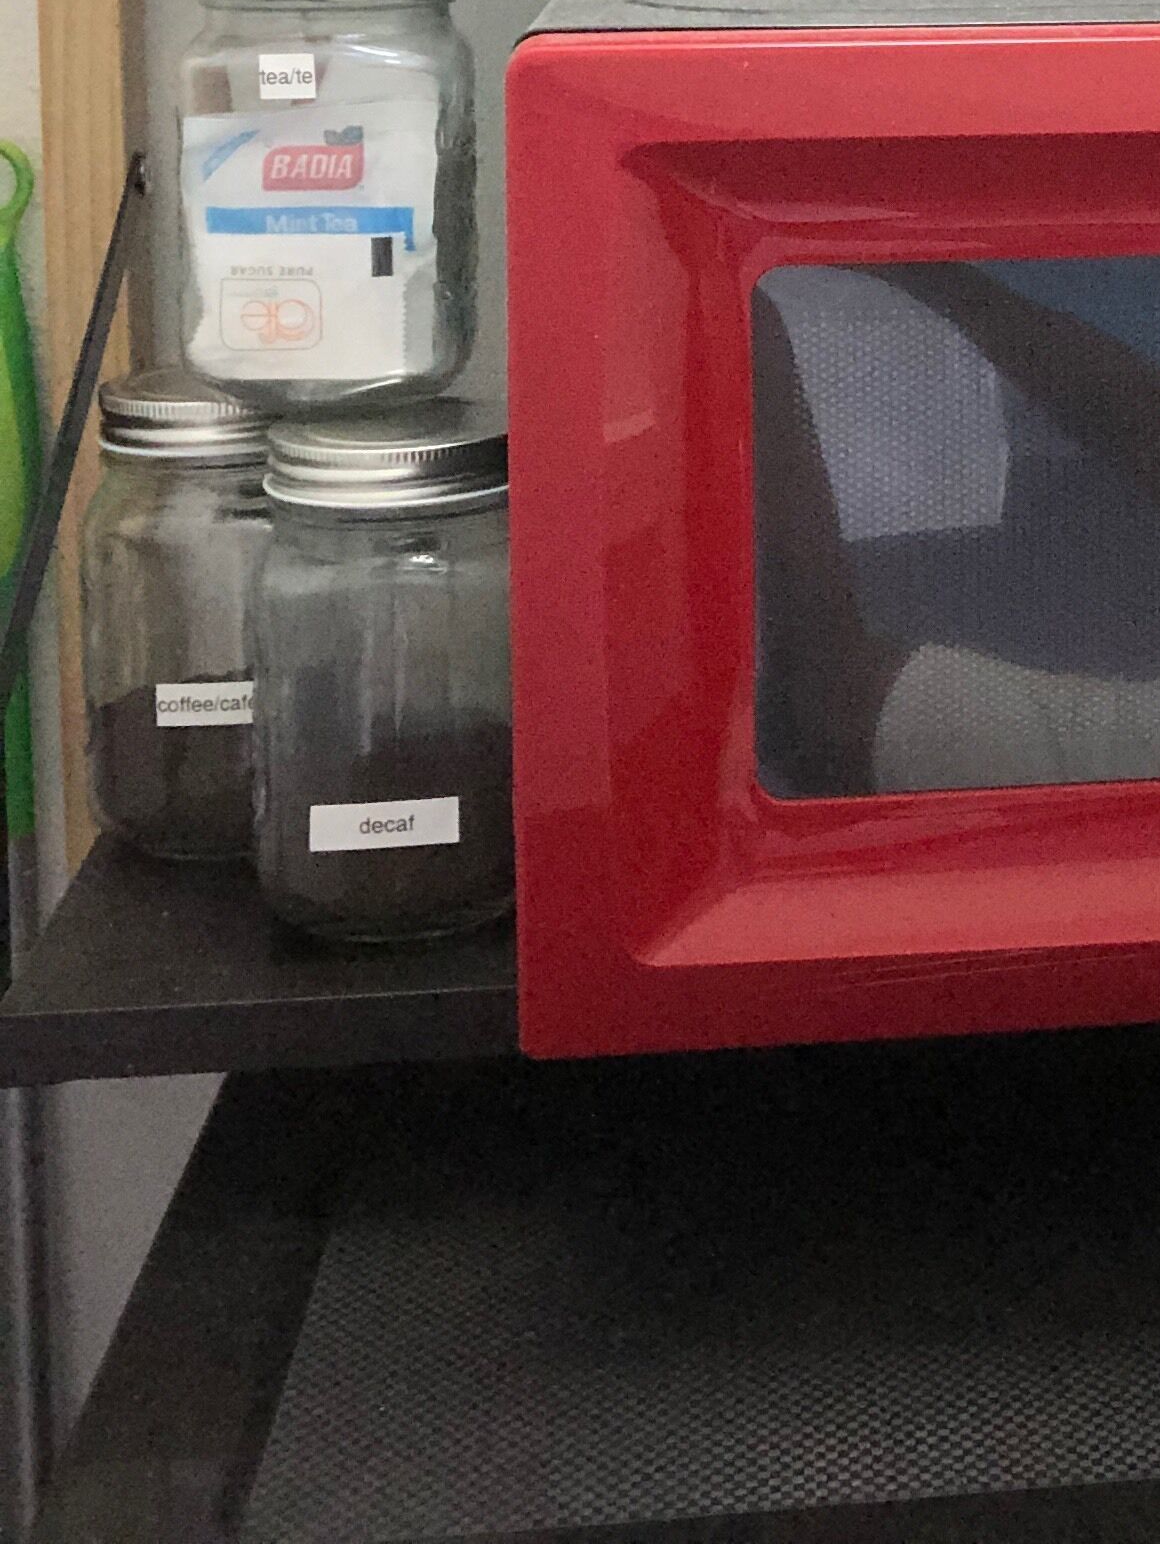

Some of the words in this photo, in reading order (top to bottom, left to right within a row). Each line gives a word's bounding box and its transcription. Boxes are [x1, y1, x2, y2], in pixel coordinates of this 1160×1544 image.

[260, 68, 313, 85] tea/te
[271, 154, 353, 179] BADIA
[266, 214, 318, 232] Mint
[321, 213, 358, 232] Tea
[230, 266, 273, 276] SUGAR
[278, 266, 313, 276] PURE
[359, 814, 415, 834] decaf
